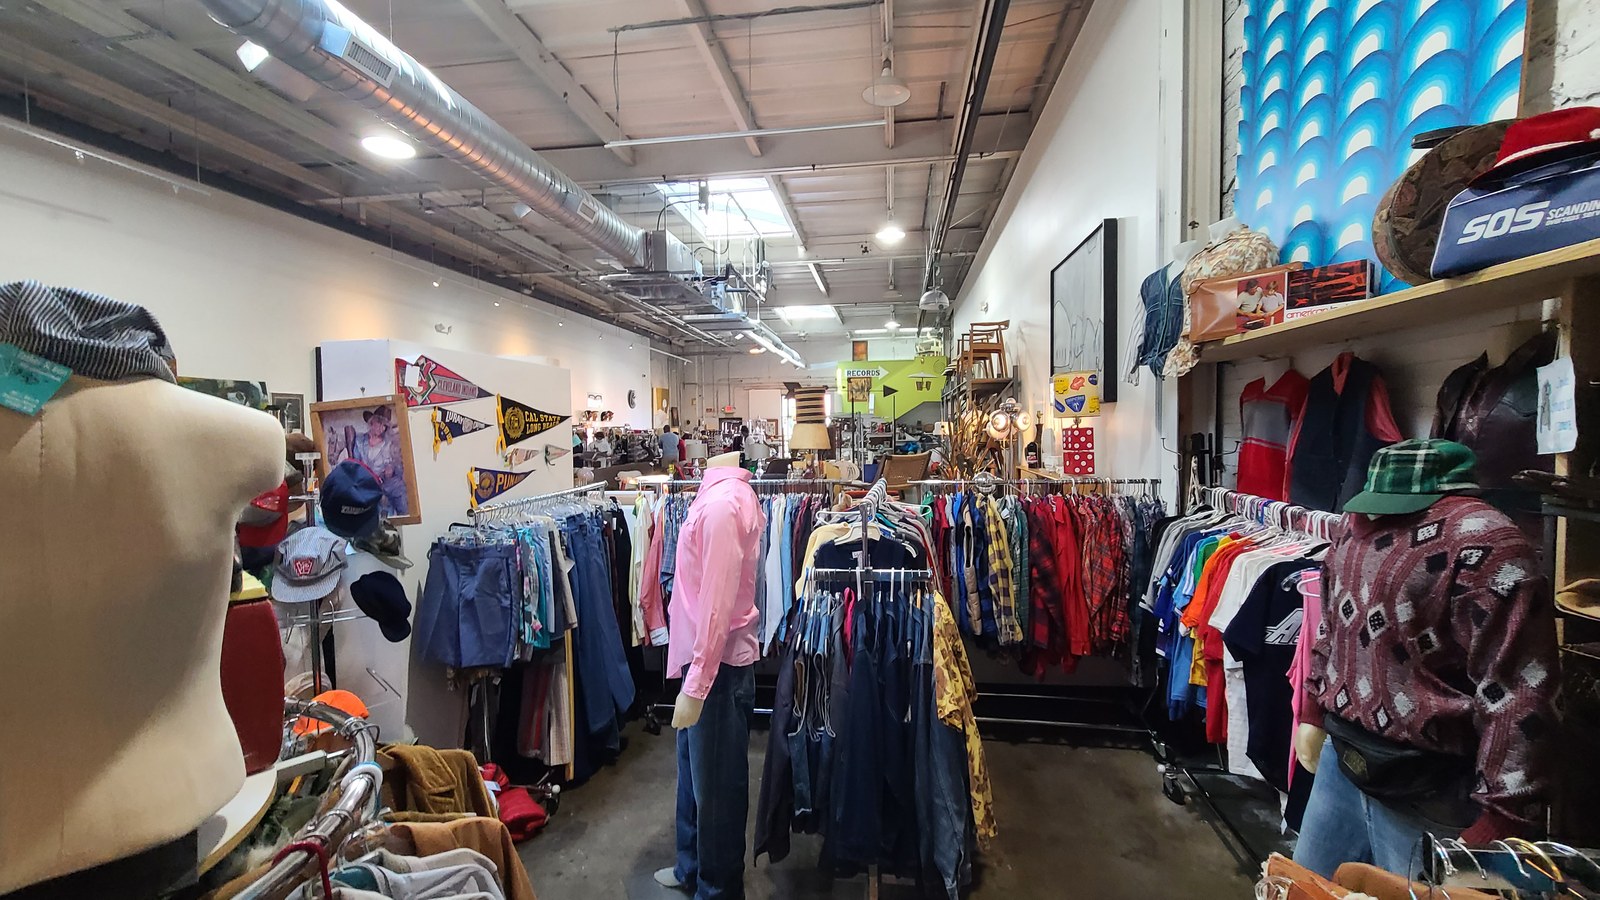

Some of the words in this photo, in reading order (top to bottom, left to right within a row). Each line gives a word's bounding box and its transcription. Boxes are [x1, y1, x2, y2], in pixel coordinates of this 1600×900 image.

[1457, 200, 1551, 245] SOS
[846, 369, 881, 377] RECORDS
[437, 379, 461, 394] CLEVELAND
[445, 410, 465, 425] LURAY
[524, 411, 539, 423] CAL
[539, 413, 561, 423] STATE
[526, 423, 542, 435] LONG
[495, 473, 524, 494] PUNA
